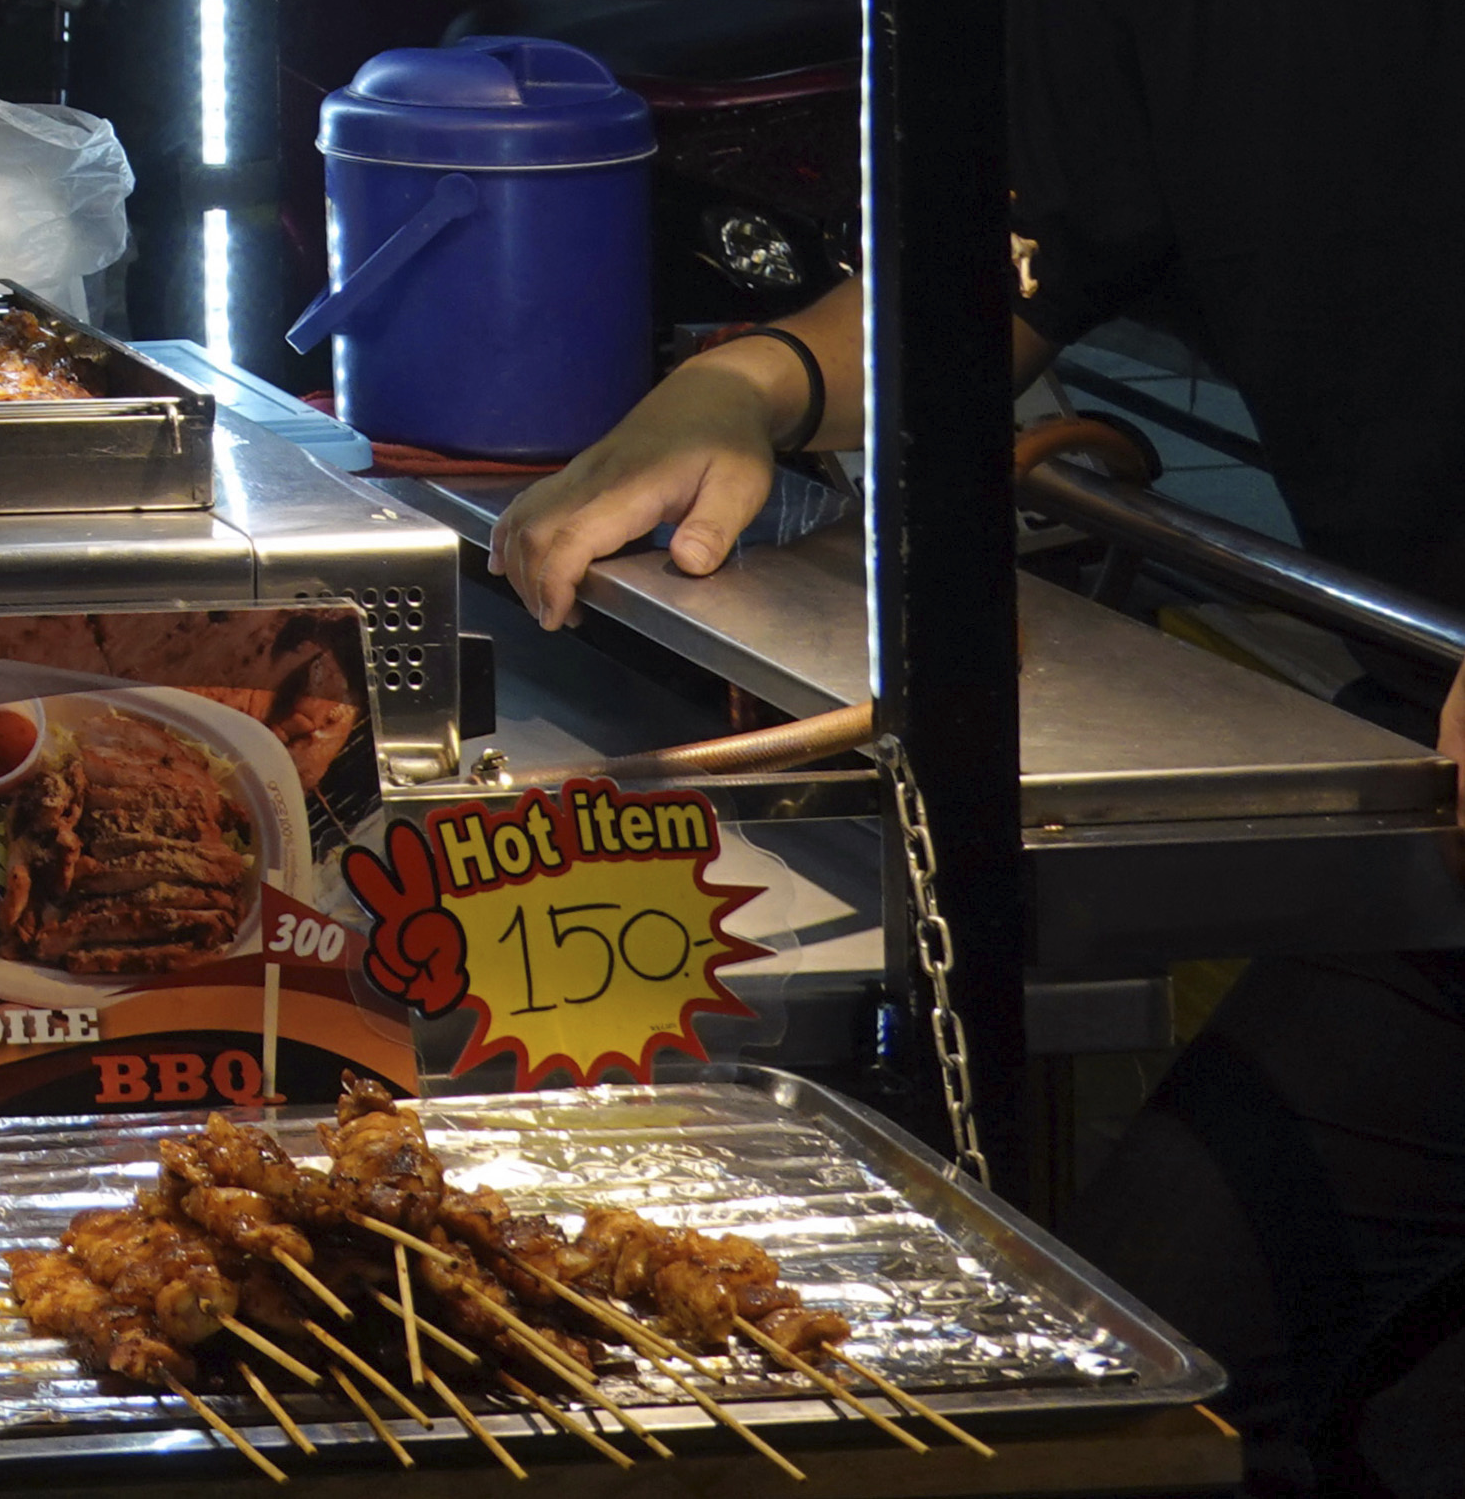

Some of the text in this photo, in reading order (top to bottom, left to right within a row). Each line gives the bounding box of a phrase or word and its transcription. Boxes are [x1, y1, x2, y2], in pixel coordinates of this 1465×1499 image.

[437, 790, 712, 889] Hot item
[268, 913, 345, 963] 300
[91, 1050, 286, 1107] BBQ
